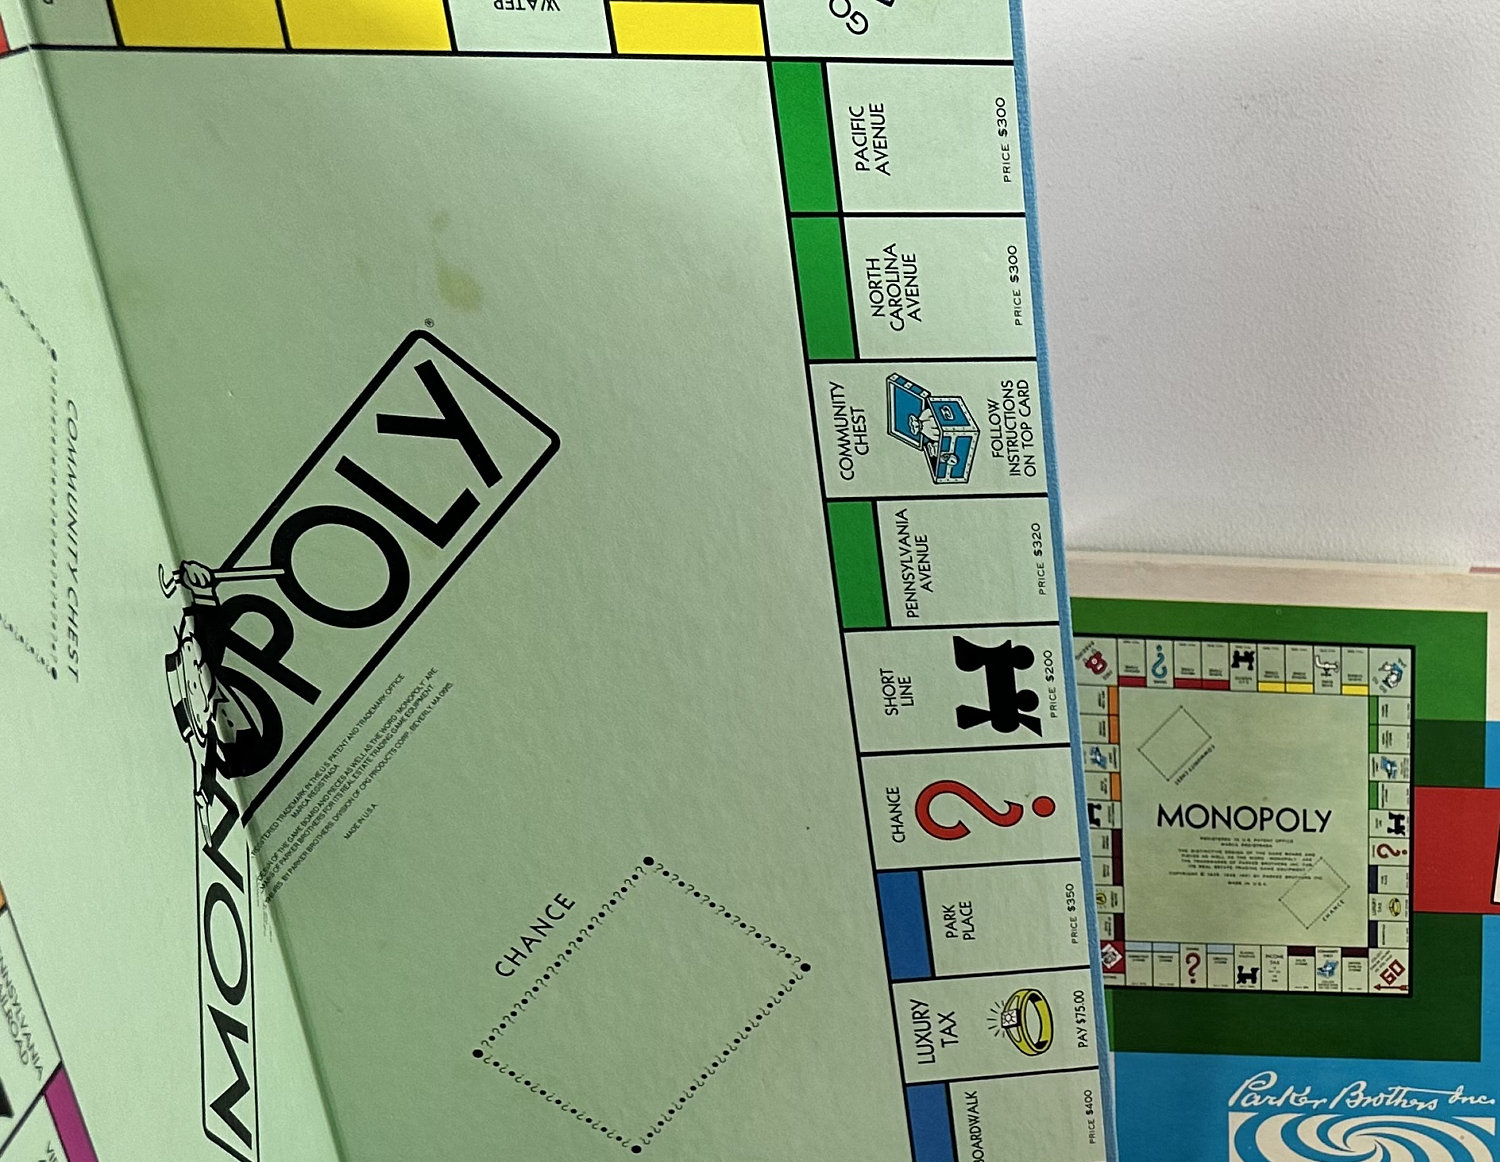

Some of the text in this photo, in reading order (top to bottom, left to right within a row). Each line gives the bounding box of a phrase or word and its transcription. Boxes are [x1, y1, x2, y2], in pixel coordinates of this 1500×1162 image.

[849, 106, 870, 171] PACIFIC
[869, 103, 890, 176] AVENUE
[995, 97, 1011, 182] PRICE $300
[866, 259, 885, 317] NORTH
[883, 243, 904, 331] CAROLINA
[902, 254, 921, 322] AVENUE
[829, 382, 854, 480] COMMUNITY
[850, 406, 869, 455] CHEST
[987, 399, 1004, 457] FOLLOW
[1001, 380, 1021, 476] INSTRUCTIONS
[1017, 380, 1036, 477] ON TOP CARD
[67, 400, 78, 683] COMMUNITY CHEST
[895, 509, 919, 617] PENNSYLVANIA
[915, 535, 933, 592] AVENUE
[880, 668, 898, 715] SHORT
[898, 676, 914, 706] LINE
[886, 787, 905, 843] CHANCE
[1158, 804, 1331, 832] MONOPOLY
[496, 893, 577, 979] CHANCE
[942, 905, 958, 938] PARK
[959, 901, 975, 940] PLACE
[910, 999, 935, 1064] LUXURY
[937, 1012, 958, 1048] TAX
[1073, 991, 1088, 1048] PAY $75.00
[1229, 1071, 1327, 1109] Parker
